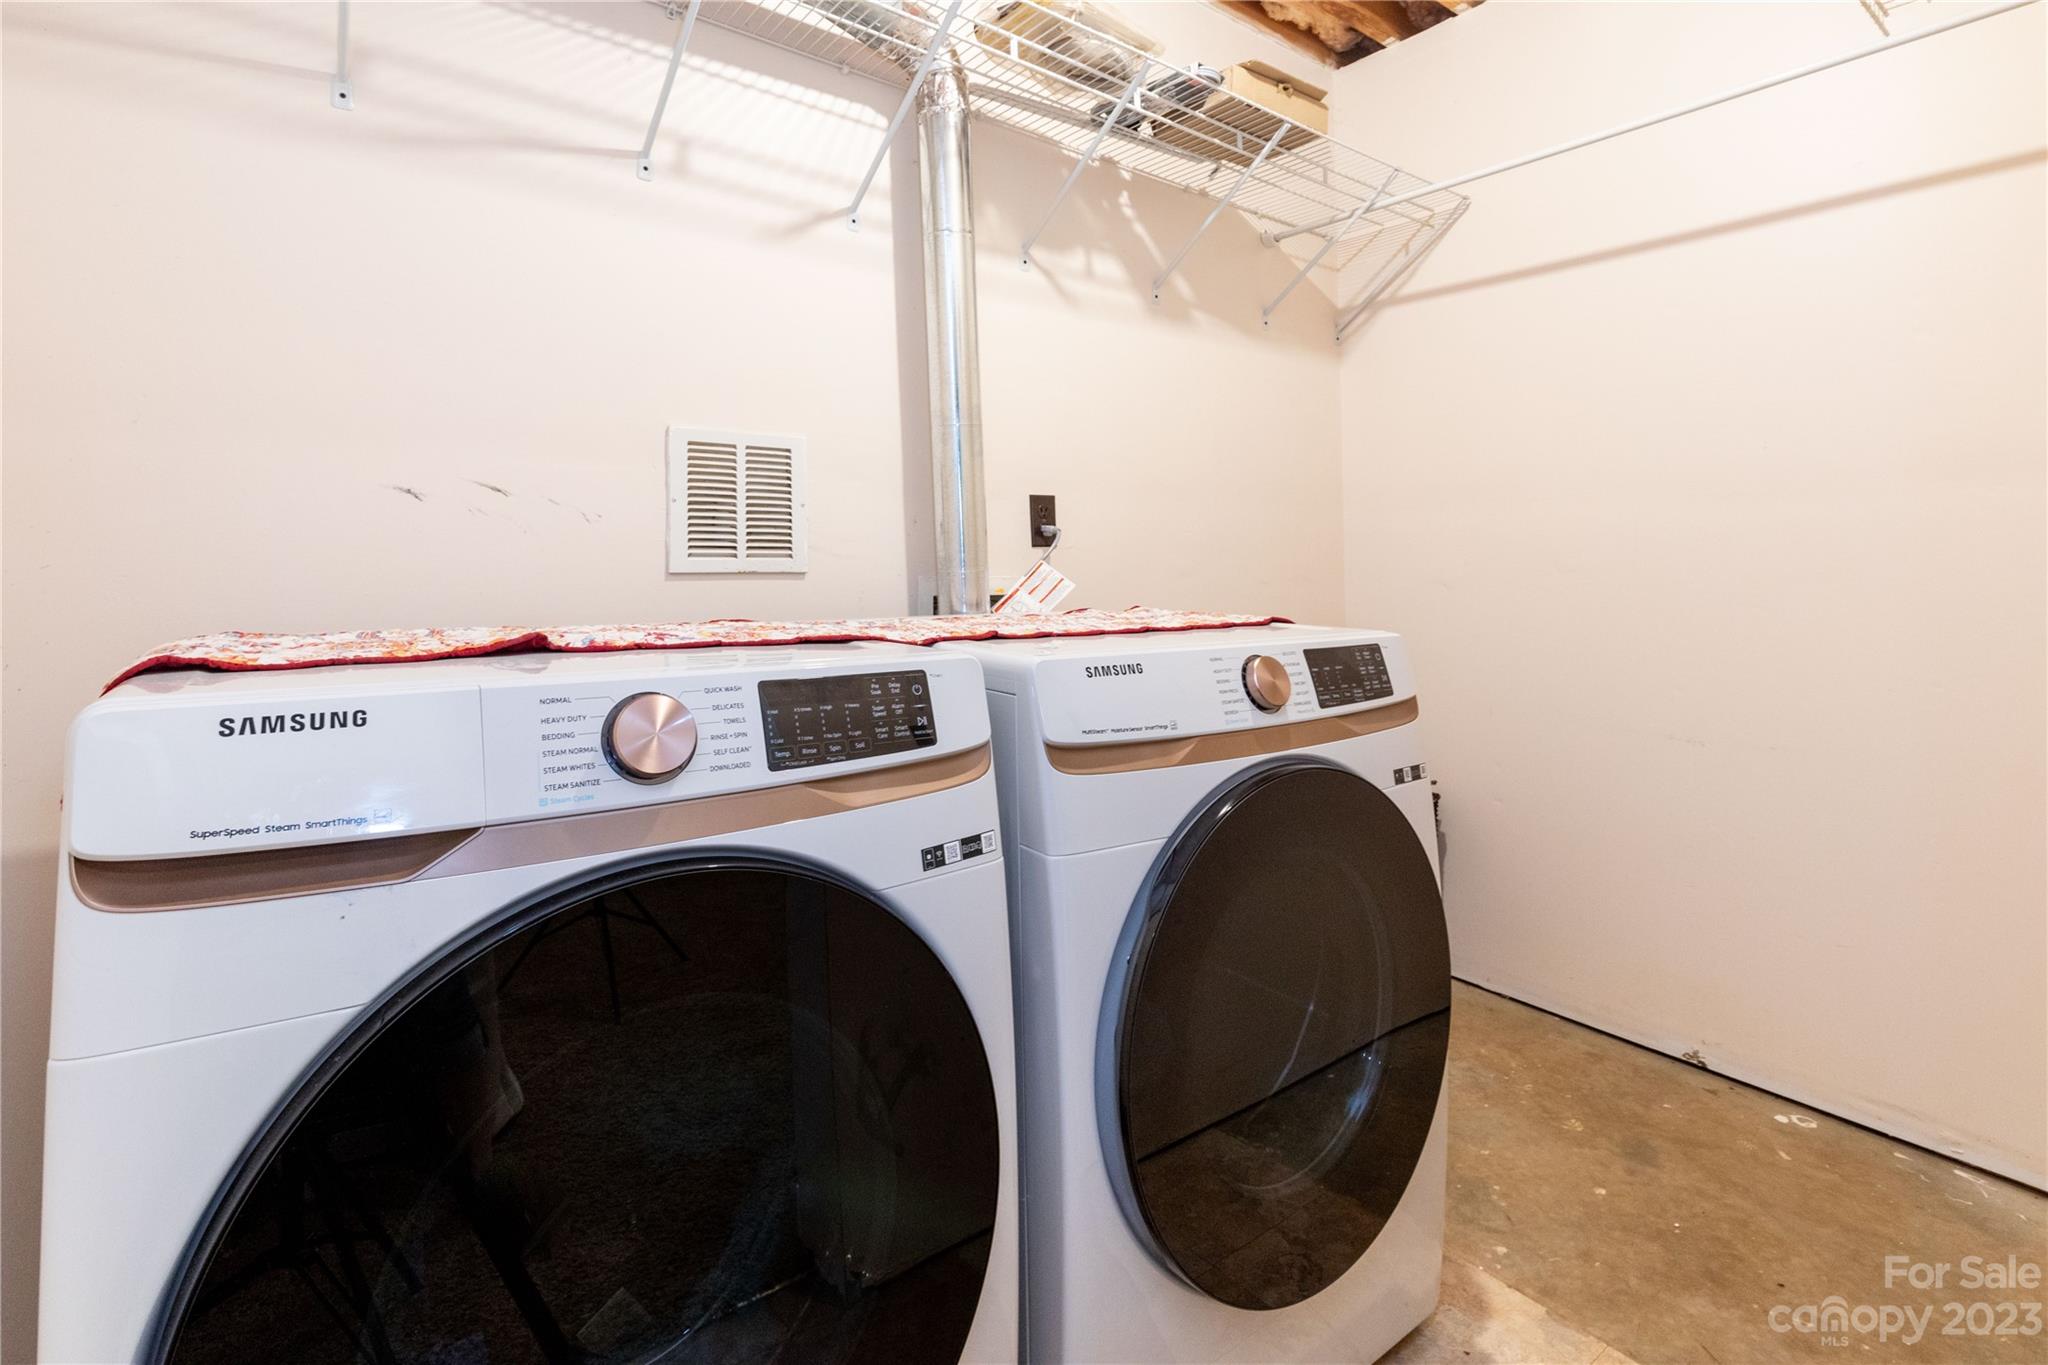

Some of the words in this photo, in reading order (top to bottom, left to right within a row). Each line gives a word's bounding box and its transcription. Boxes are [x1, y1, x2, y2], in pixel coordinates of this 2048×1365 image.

[1085, 662, 1143, 678] SAMSUNG
[703, 686, 723, 694] QUICK
[723, 685, 743, 693] WASH
[539, 696, 571, 705] NORMAL
[711, 702, 744, 711] DELICATES
[218, 709, 368, 738] SAMSUNG
[540, 715, 565, 725] HEAVY
[566, 714, 587, 723] DUTY
[723, 717, 746, 725] TOWELS
[541, 731, 576, 741] BEDDING
[710, 732, 729, 740] RINSE
[732, 731, 748, 739] SPIN
[542, 748, 565, 758] STEAM
[567, 746, 598, 755] NORMAL
[713, 747, 728, 756] SELF
[543, 764, 568, 774] STEAM
[569, 762, 596, 771] WHITES
[709, 761, 752, 772] DOWNLOADED
[544, 781, 569, 792] STEAM
[570, 779, 600, 789] SANITIZE
[190, 825, 260, 840] SuperSpeed
[265, 822, 300, 833] Steam
[305, 815, 368, 830] SmartThings
